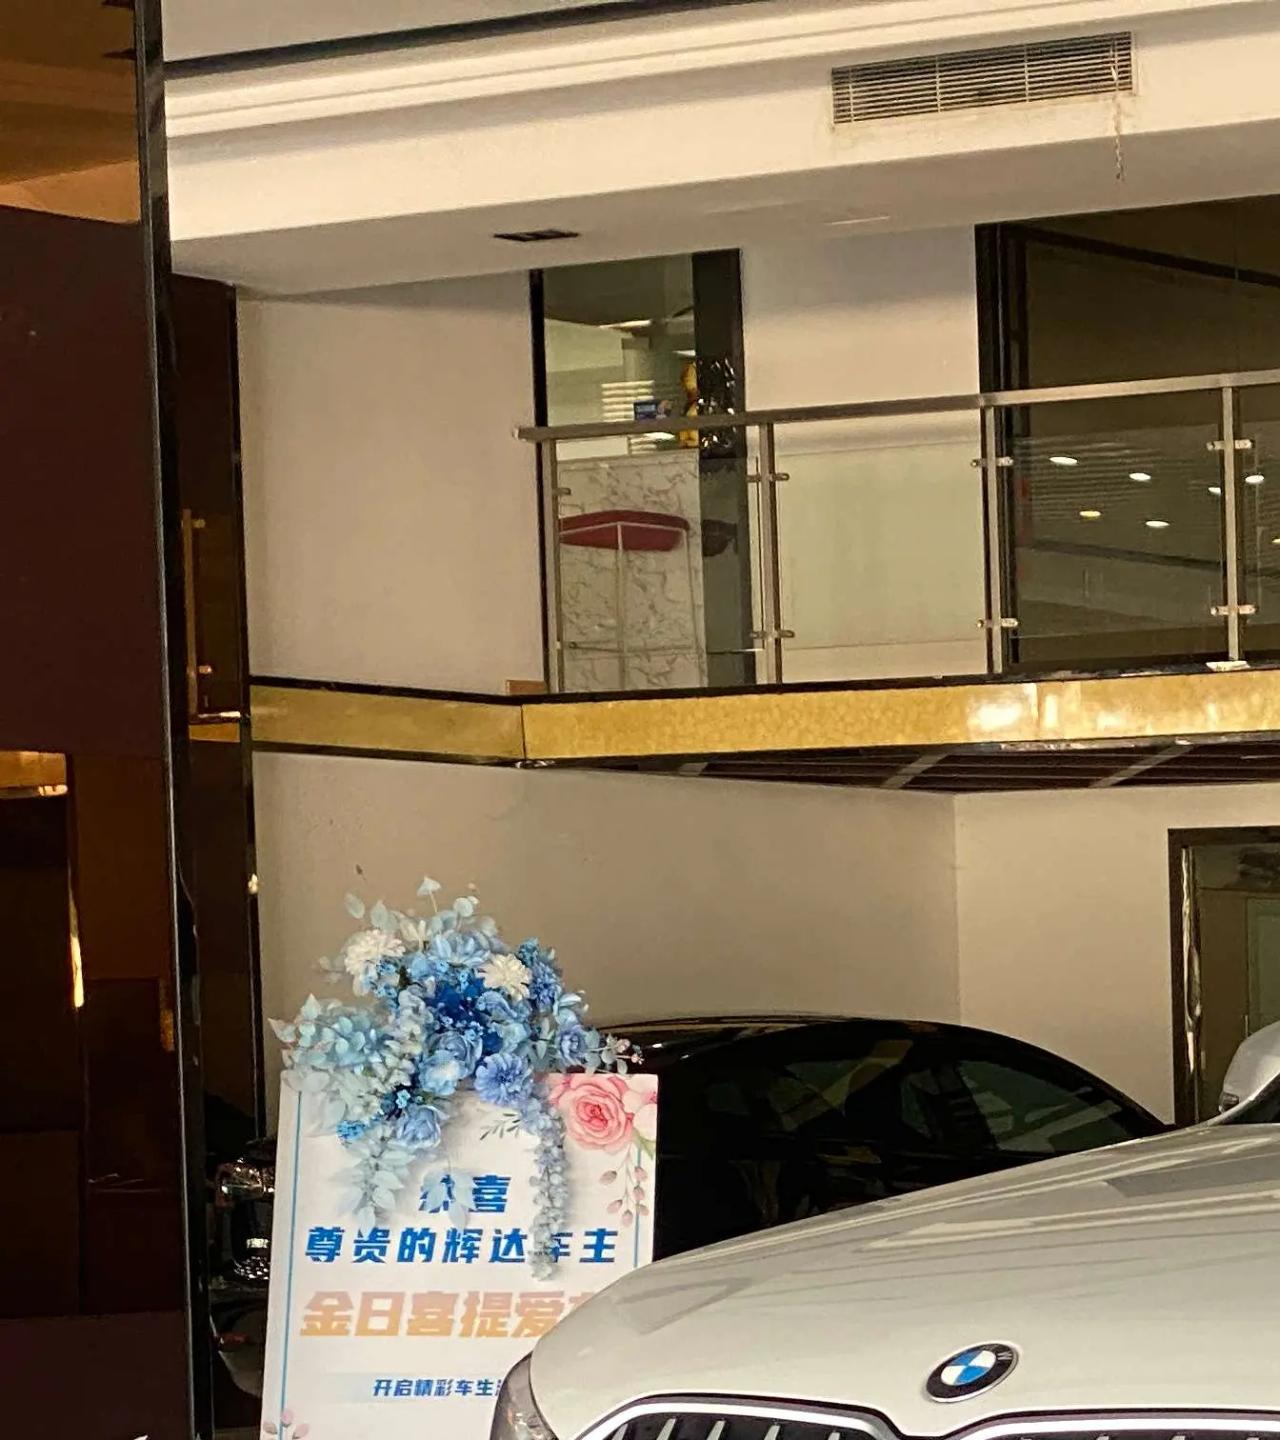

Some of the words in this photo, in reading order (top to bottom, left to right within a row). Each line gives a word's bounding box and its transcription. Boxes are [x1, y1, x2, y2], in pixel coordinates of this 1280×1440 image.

[302, 1291, 594, 1337] 金日喜提爱
